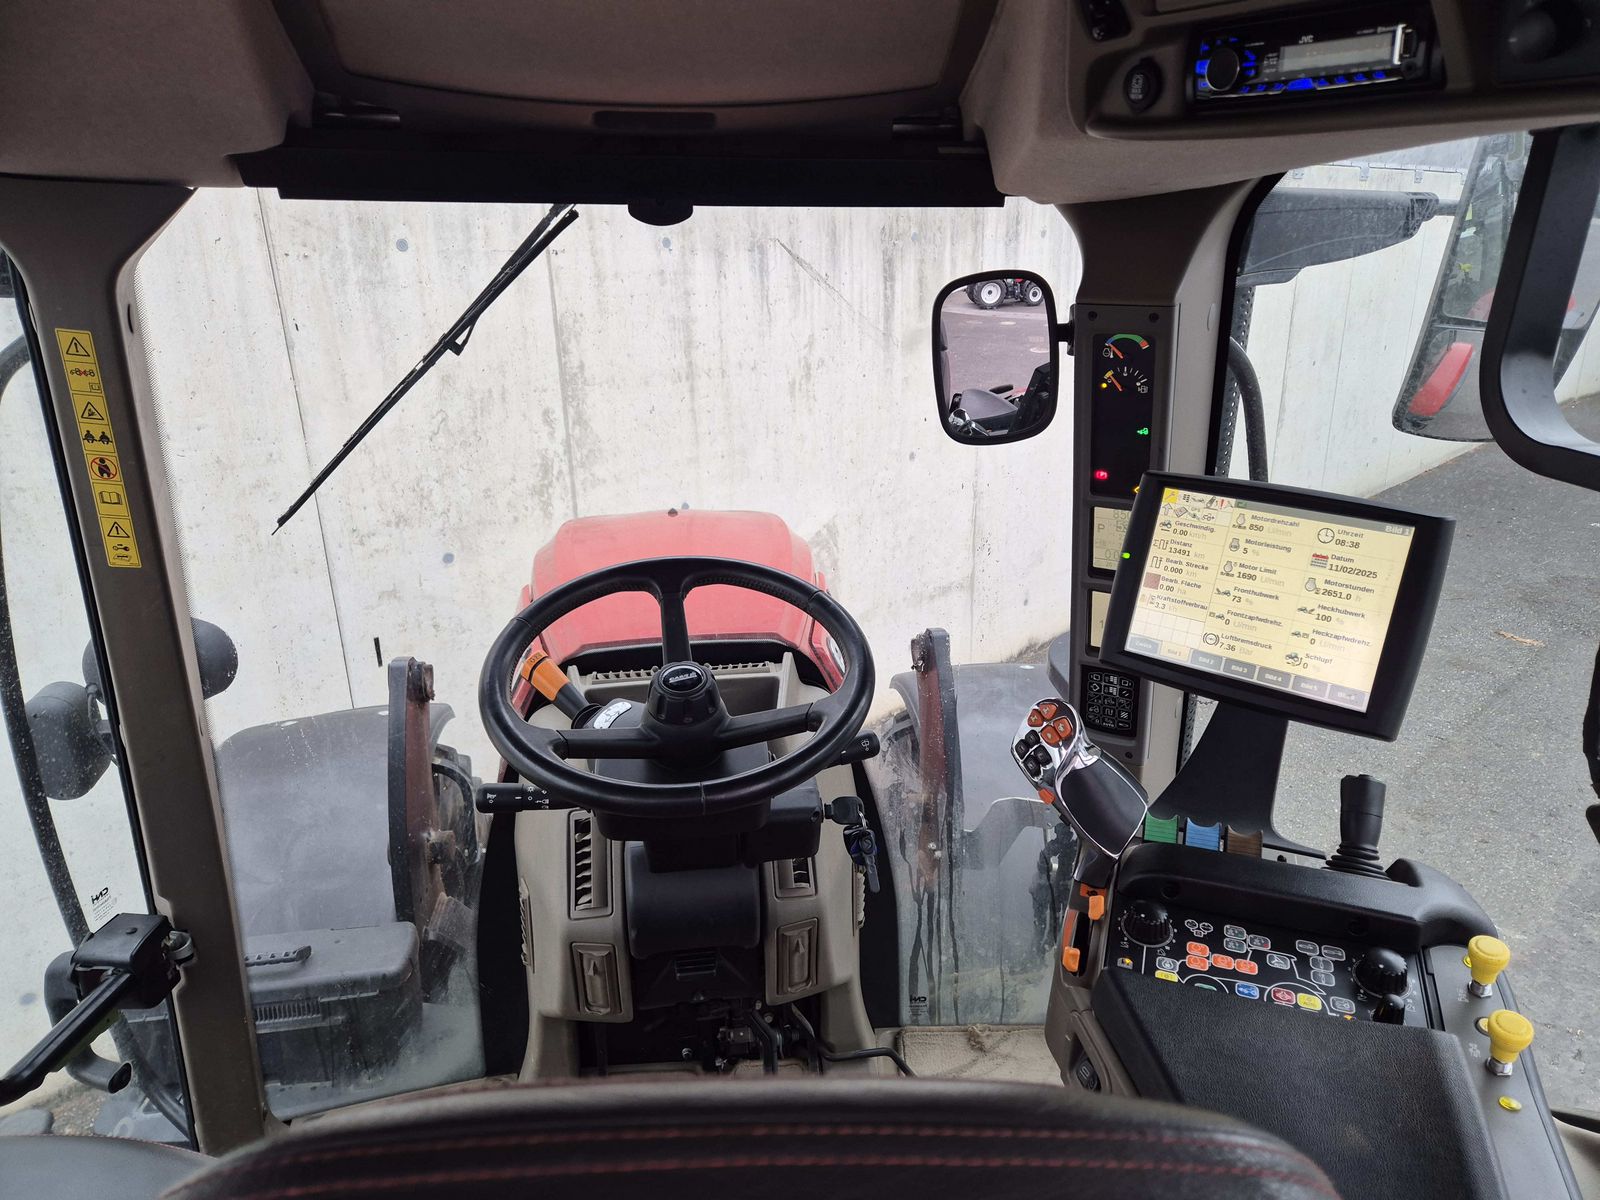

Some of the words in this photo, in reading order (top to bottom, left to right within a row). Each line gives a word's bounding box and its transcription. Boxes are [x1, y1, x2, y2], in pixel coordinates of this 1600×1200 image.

[1299, 35, 1314, 44] JVC
[1251, 514, 1300, 527] Motordrehzahl
[1175, 520, 1215, 533] Geschwindig.
[1385, 525, 1402, 534] Bild
[1337, 529, 1364, 538] Uhrzeit
[1170, 539, 1192, 548] Distanz
[1245, 539, 1291, 552] Motorleistung
[1335, 539, 1360, 549] 08:38
[1169, 547, 1190, 556] 13491
[1331, 554, 1354, 563] Datum
[1164, 566, 1183, 574] 0.000
[1186, 561, 1208, 570] Strecke
[1239, 563, 1258, 571] Motor
[1259, 566, 1277, 574] Limit
[1237, 572, 1257, 581] 1690
[1328, 564, 1378, 579] 11/02/2025
[1159, 584, 1174, 592] 0.00
[1324, 579, 1374, 594] Motorstunden
[1234, 586, 1279, 600] Fronthubwerk
[1322, 588, 1352, 600] 2651.0
[1157, 594, 1208, 610] Kraftstoffverbrau
[1318, 604, 1366, 618] Heckhubwerk
[1315, 614, 1332, 623] 100
[1219, 642, 1236, 651] 7.36
[1221, 633, 1272, 650] Luftbremsdruck
[1305, 653, 1333, 664] Schlupf
